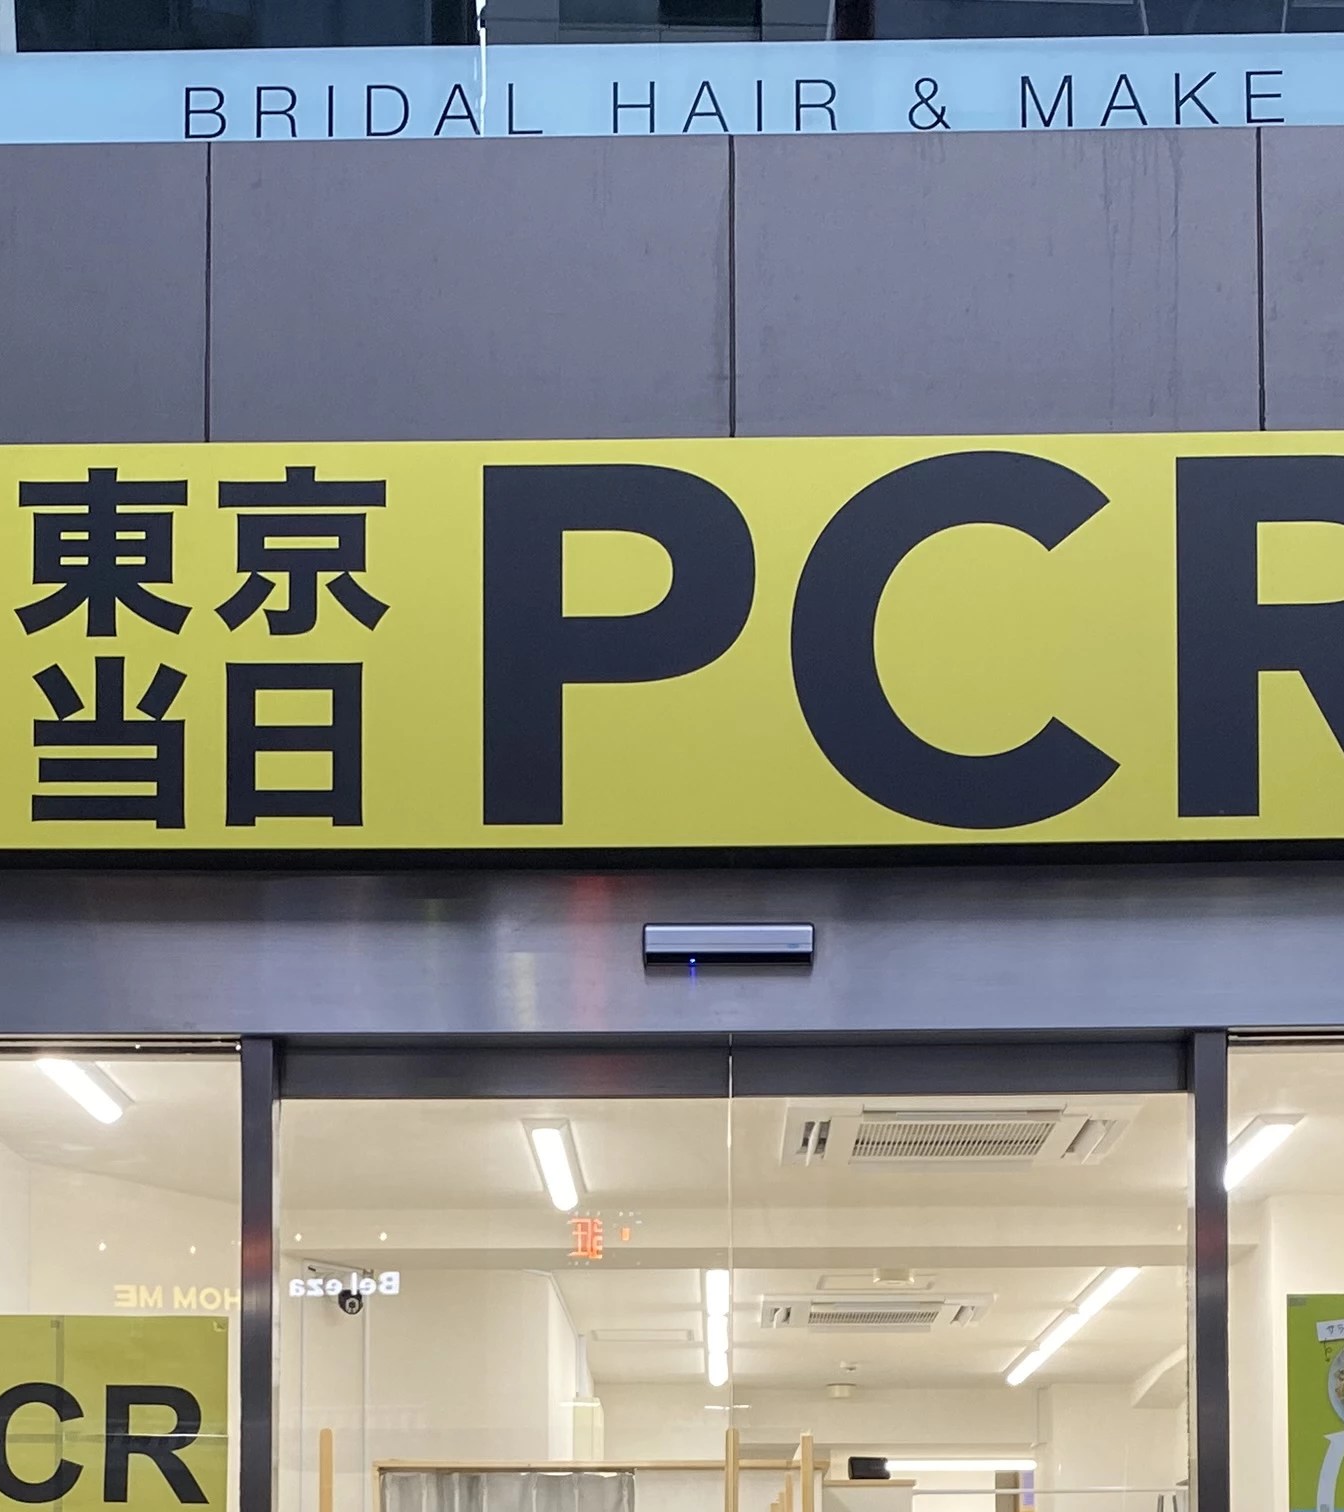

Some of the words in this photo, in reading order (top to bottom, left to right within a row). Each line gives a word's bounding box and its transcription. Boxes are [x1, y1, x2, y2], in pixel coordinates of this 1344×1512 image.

[184, 82, 544, 138] BRIDAL
[612, 77, 839, 134] HAIR
[908, 75, 951, 130] &
[1020, 69, 1285, 128] MAKE
[16, 466, 388, 638] 東京
[30, 656, 365, 830] 当日
